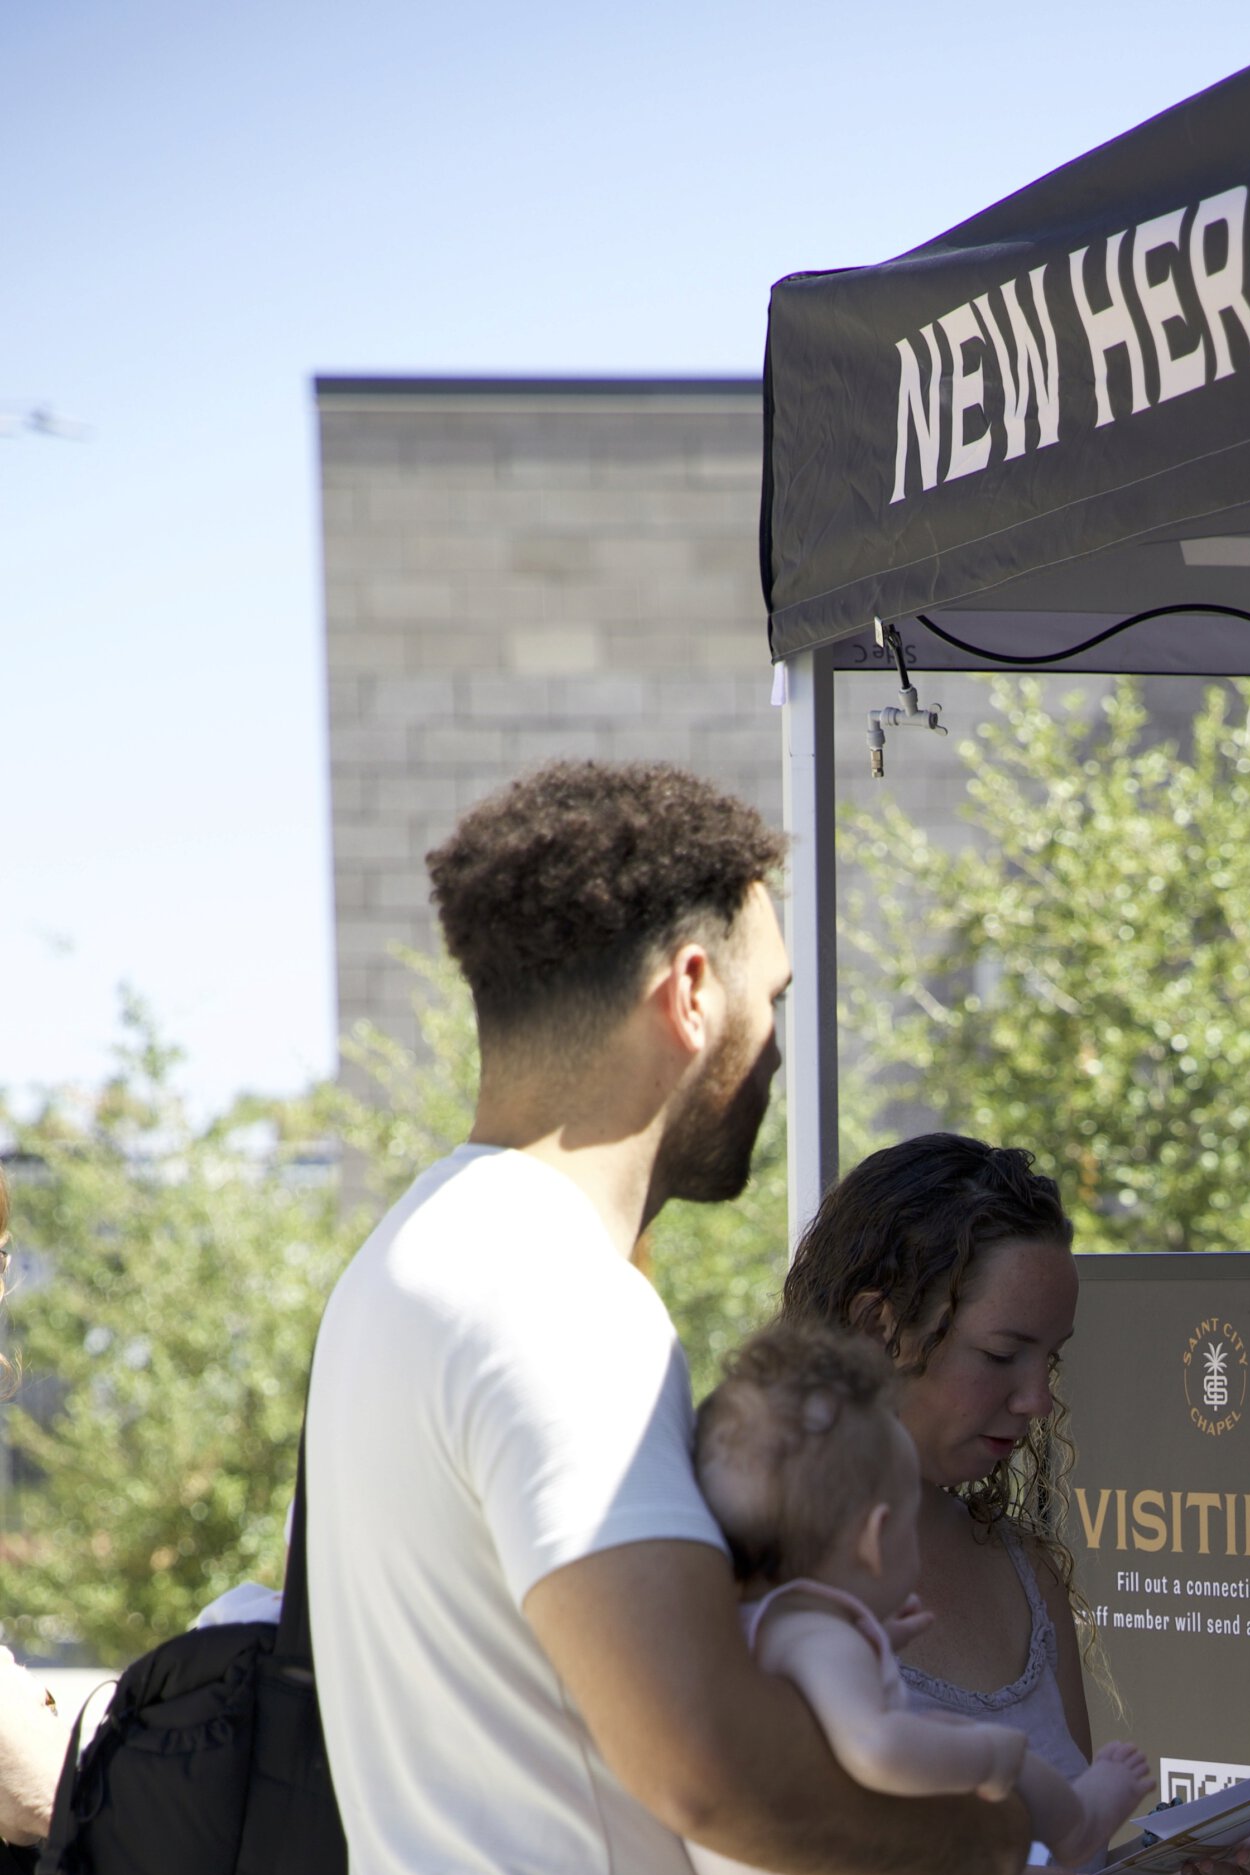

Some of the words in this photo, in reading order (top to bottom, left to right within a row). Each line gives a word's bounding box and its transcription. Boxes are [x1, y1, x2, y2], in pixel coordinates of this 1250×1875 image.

[889, 263, 1060, 505] NEW
[1183, 1318, 1219, 1366] SAINT
[1223, 1323, 1248, 1366] CITY
[1191, 1407, 1242, 1436] CHAPEL
[1117, 1571, 1139, 1592] Fill
[1144, 1576, 1168, 1594] out
[1173, 1579, 1181, 1594] a
[1113, 1609, 1169, 1630] member
[1175, 1612, 1201, 1632] will
[1207, 1614, 1240, 1634] send
